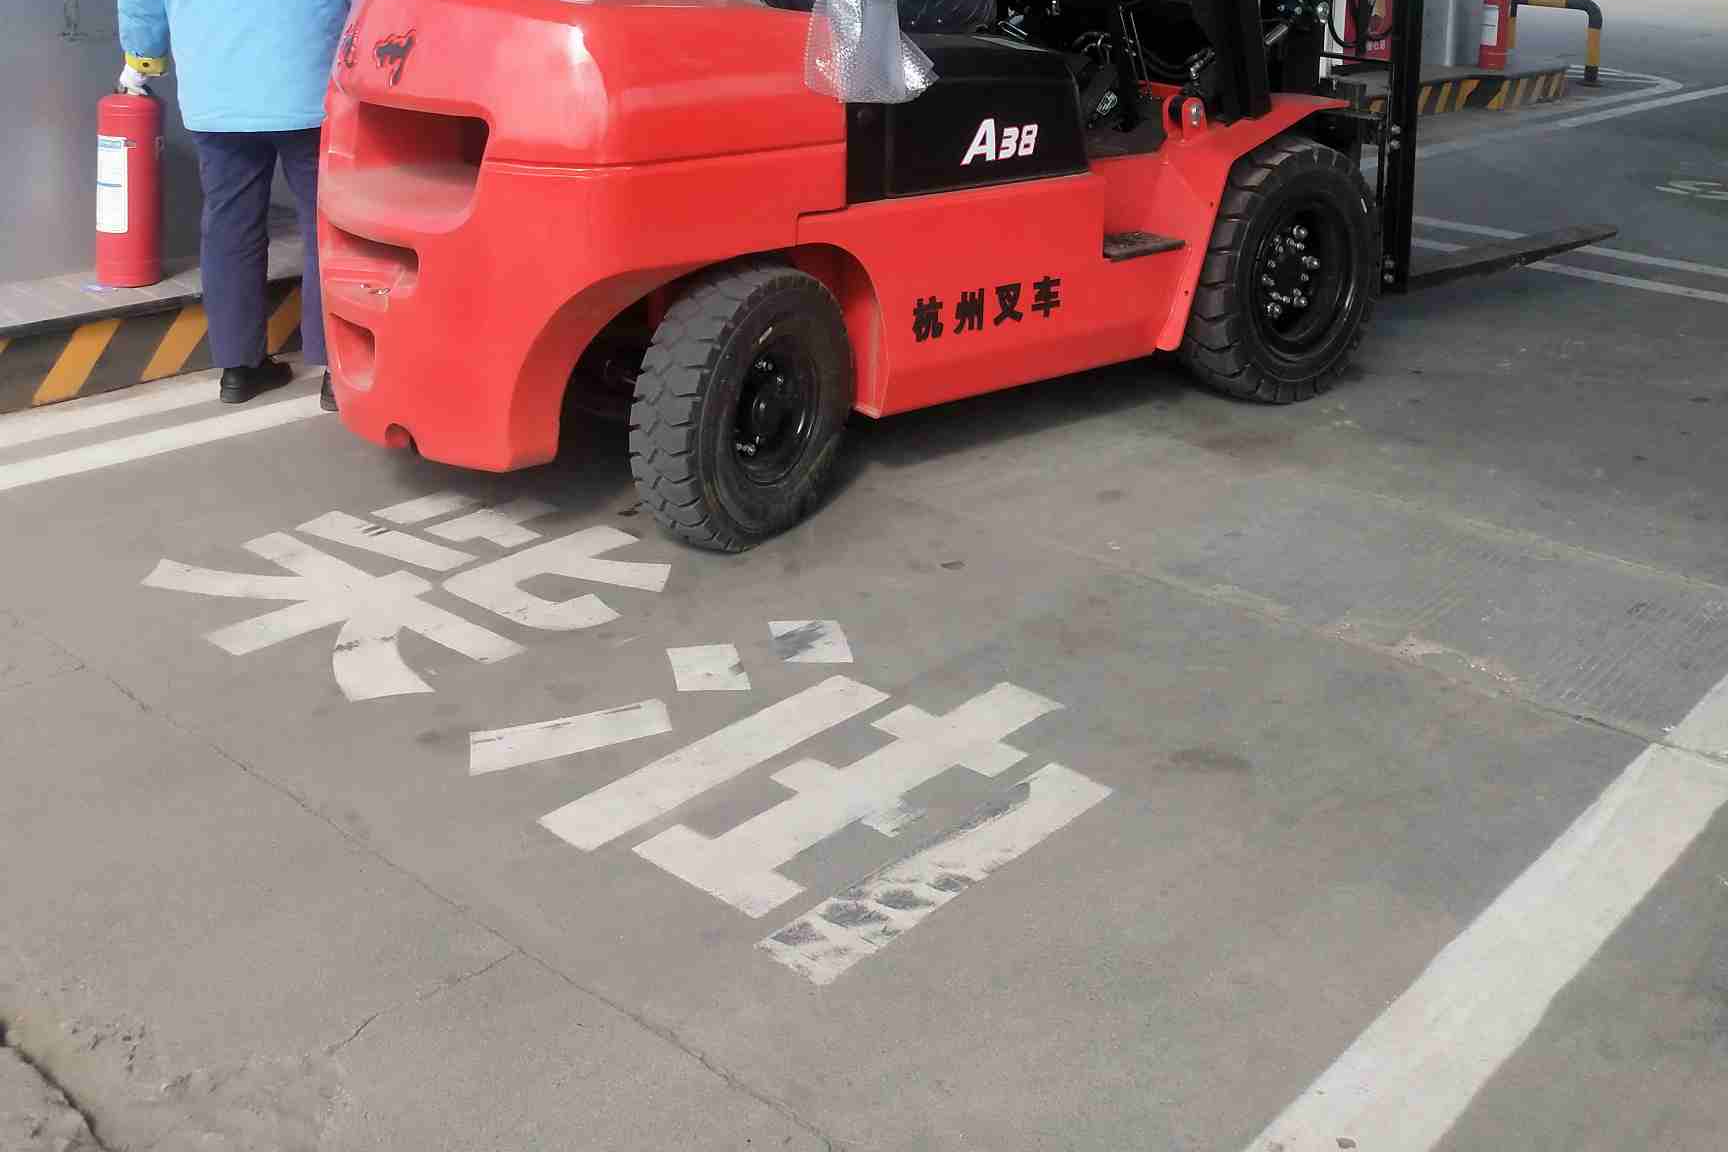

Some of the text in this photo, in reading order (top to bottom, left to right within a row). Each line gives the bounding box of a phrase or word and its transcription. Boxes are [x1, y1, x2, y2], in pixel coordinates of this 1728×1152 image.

[960, 117, 1039, 166] A38
[911, 275, 1062, 343] 杭州叉车
